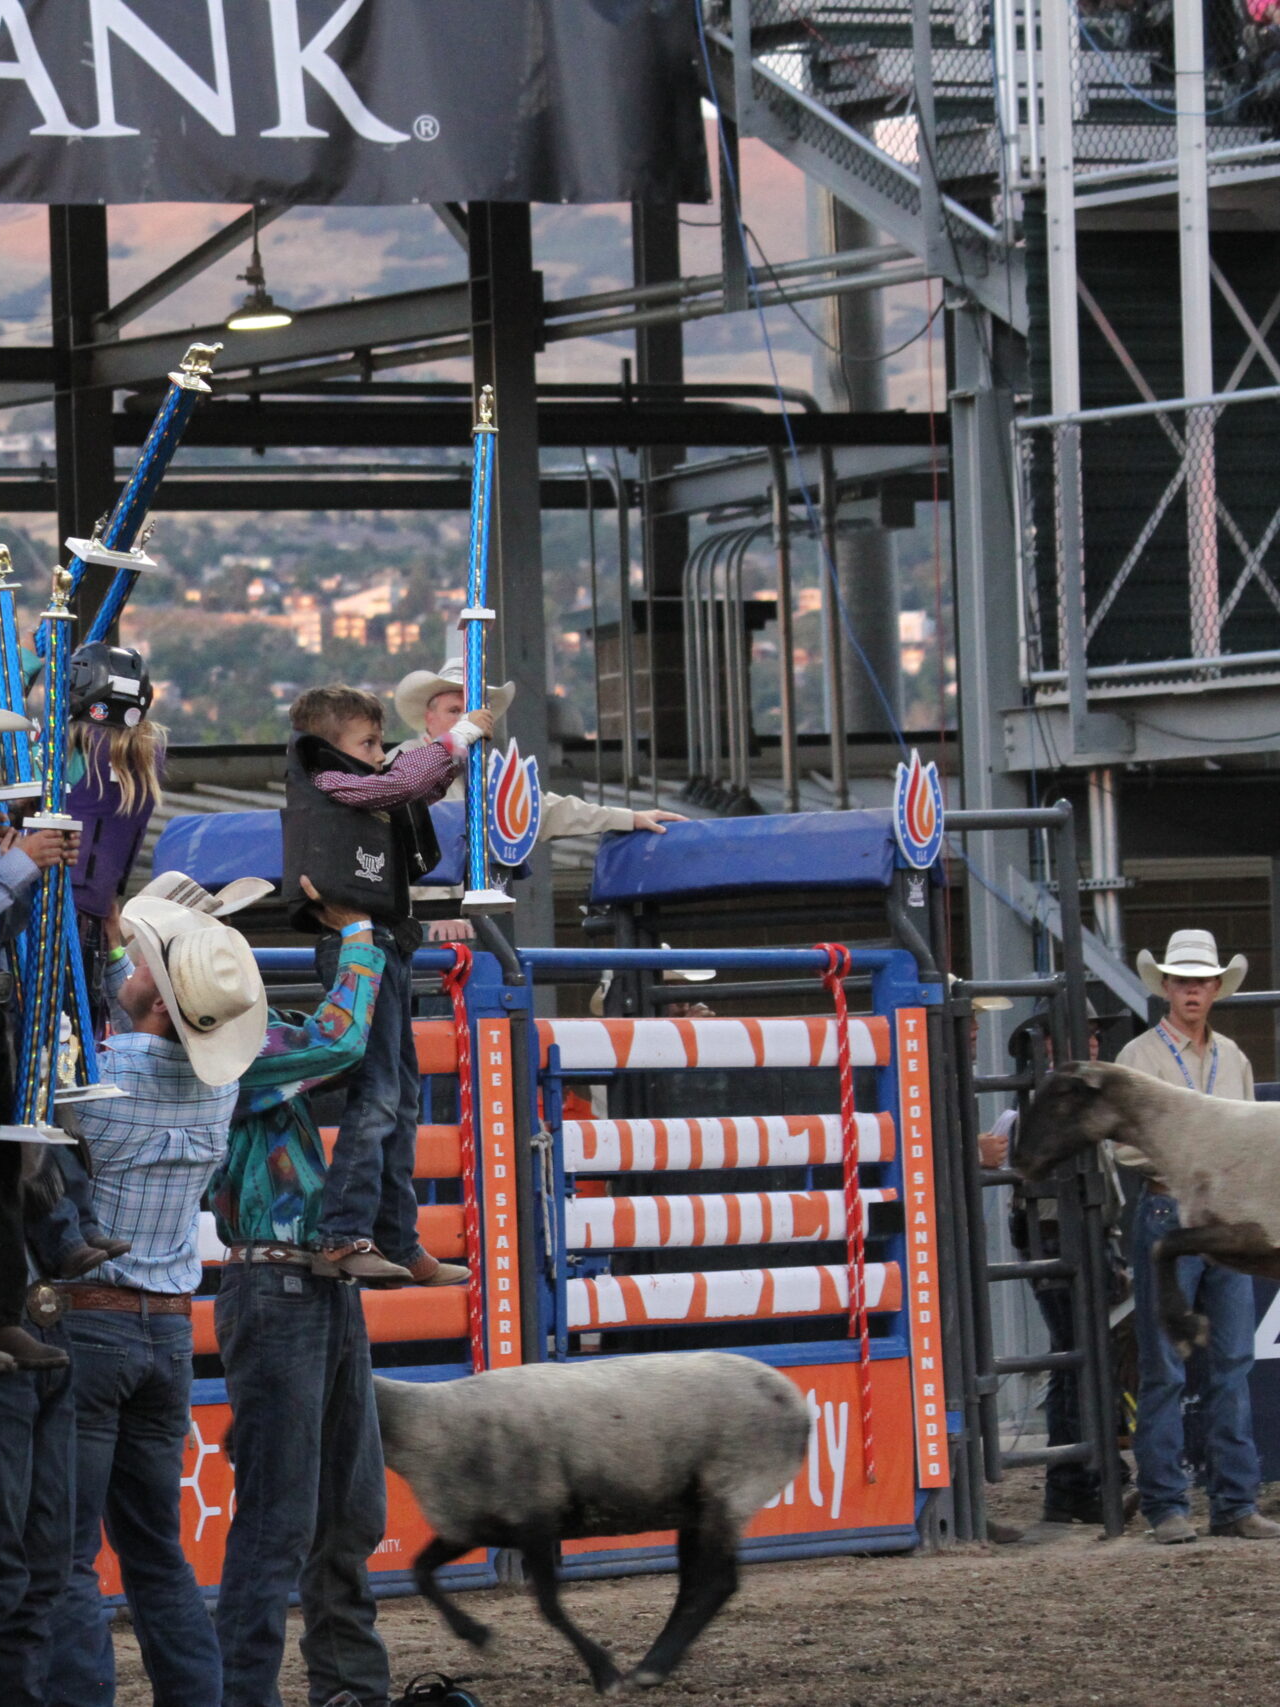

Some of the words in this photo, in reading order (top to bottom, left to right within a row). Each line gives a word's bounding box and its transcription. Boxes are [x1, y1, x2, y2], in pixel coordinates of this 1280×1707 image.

[489, 1030, 503, 1087] THE
[905, 1019, 919, 1072] THE
[492, 1101, 507, 1179] GOLD
[909, 1085, 923, 1158] GOLD
[495, 1193, 512, 1355] STANDARD
[913, 1172, 931, 1323] STANDARD
[921, 1337, 934, 1370] IN
[923, 1383, 940, 1476] RODEO
